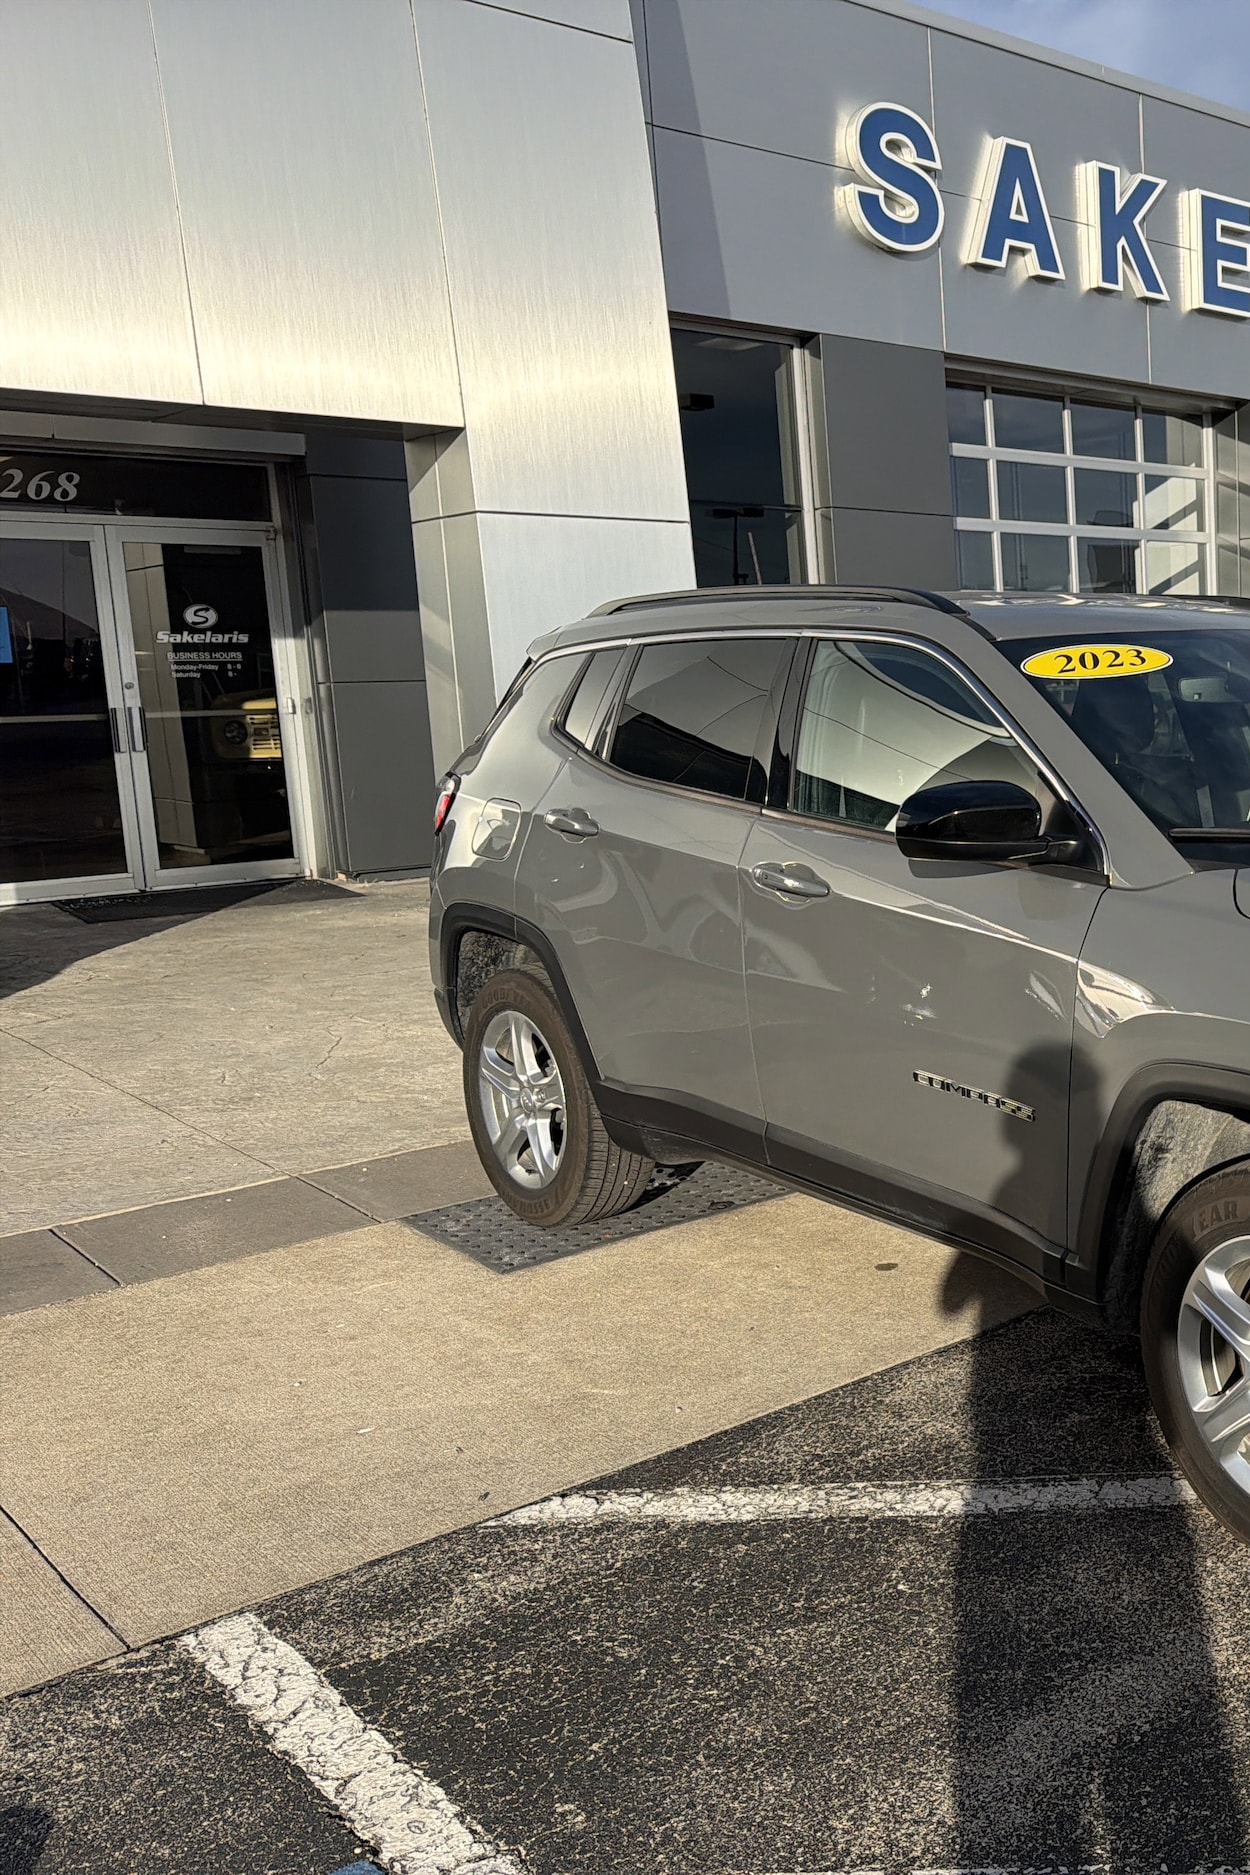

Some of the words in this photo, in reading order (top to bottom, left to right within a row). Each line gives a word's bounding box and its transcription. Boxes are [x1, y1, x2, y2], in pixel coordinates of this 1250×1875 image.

[0, 468, 81, 502] 268
[156, 630, 250, 644] Sakelaris
[167, 651, 211, 660] BUSINESS
[211, 651, 242, 660] HOURS
[1054, 648, 1147, 674] 2023
[170, 663, 219, 672] Monday-Friday
[171, 671, 201, 679] Saturday
[912, 1069, 1036, 1122] COMPASS
